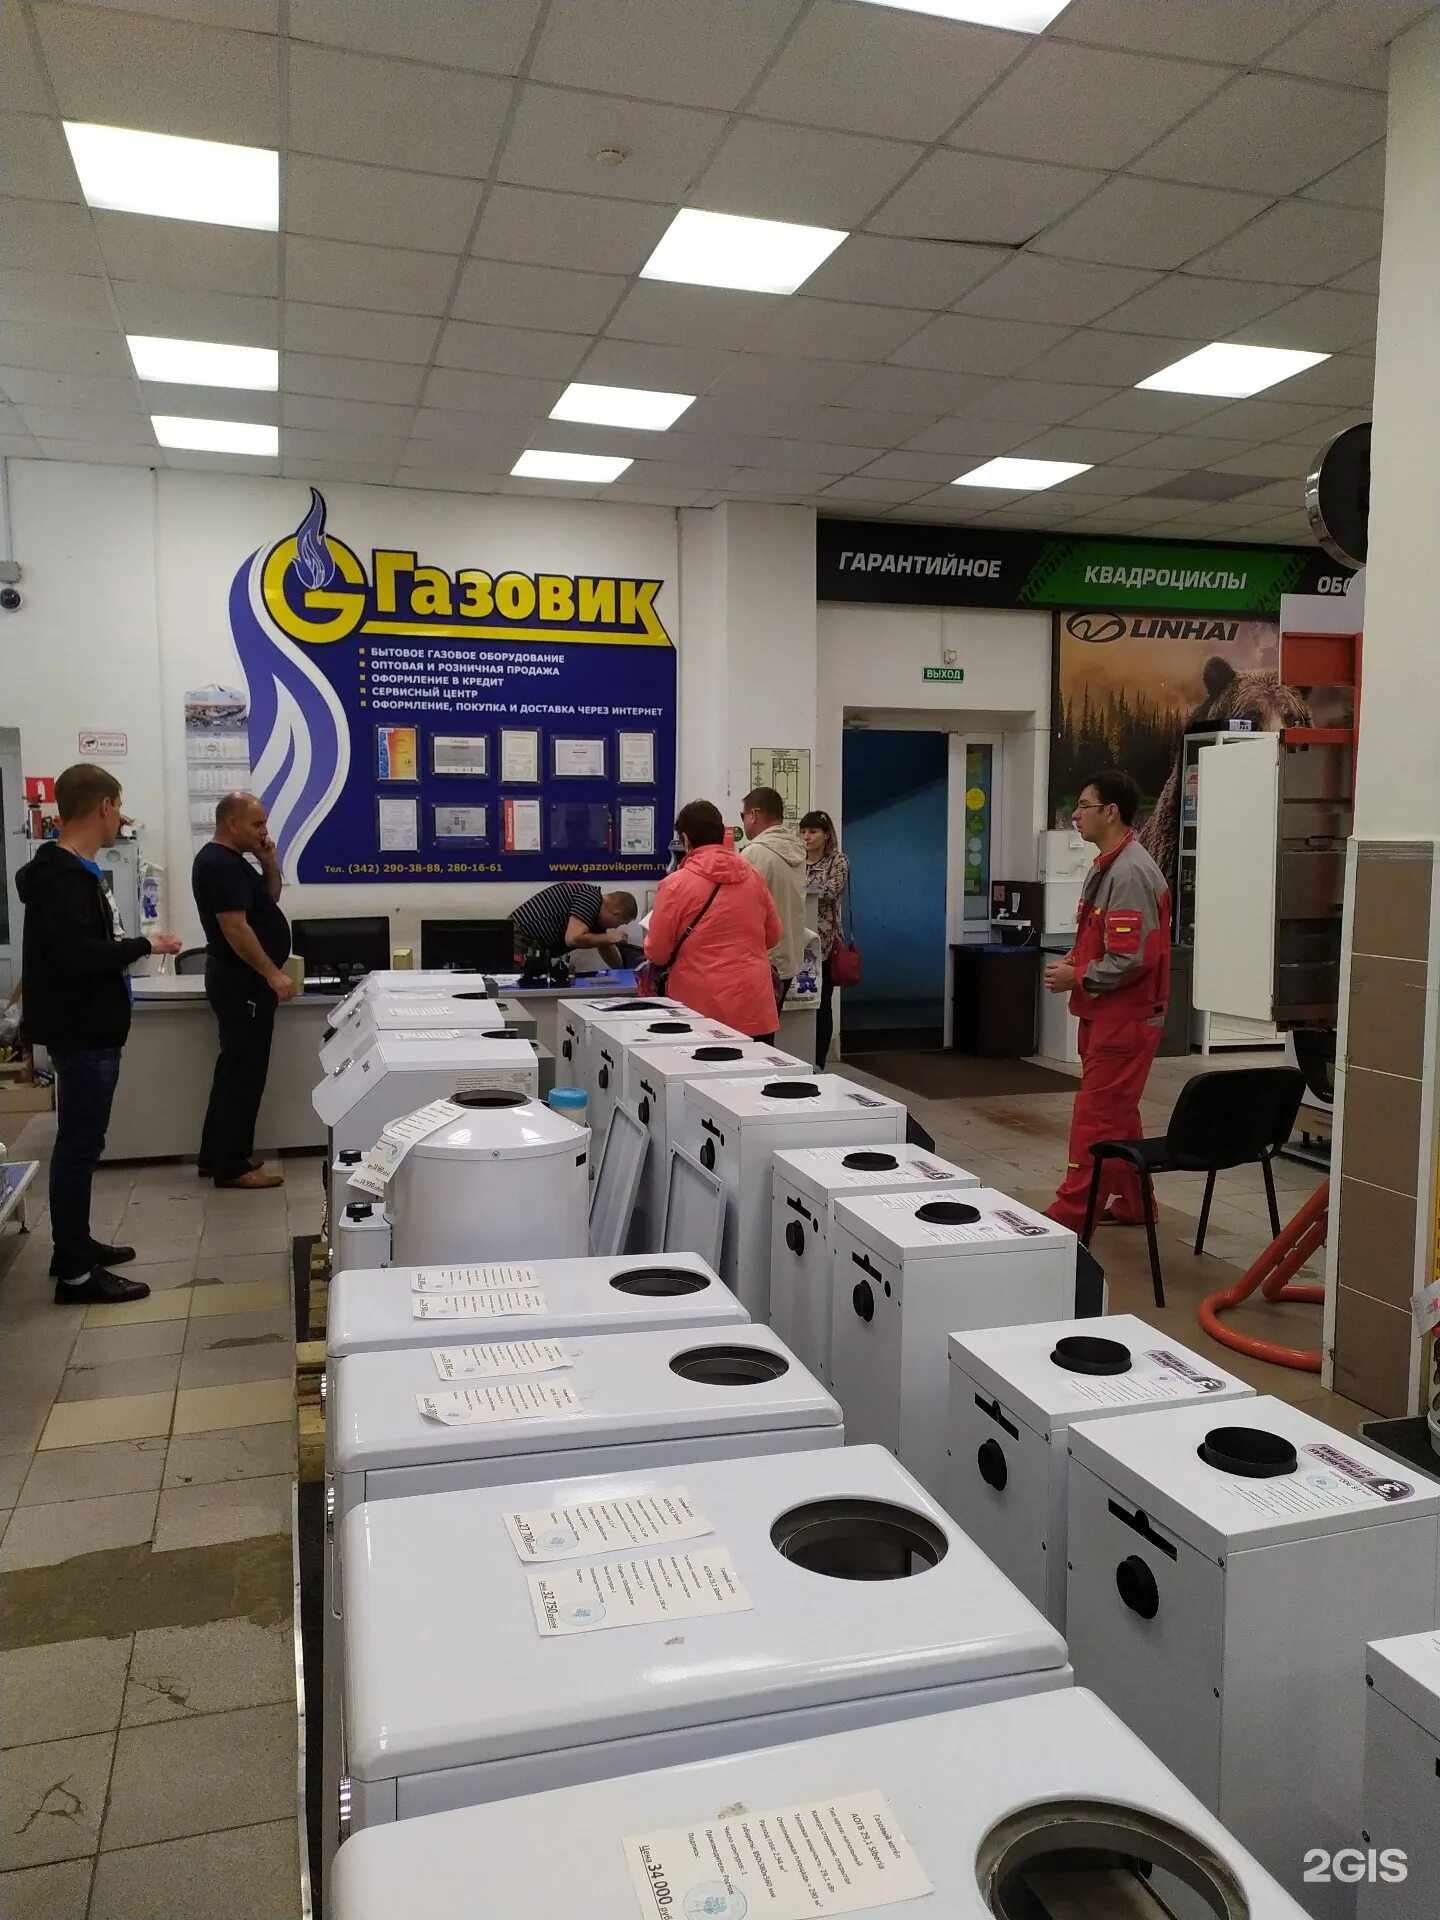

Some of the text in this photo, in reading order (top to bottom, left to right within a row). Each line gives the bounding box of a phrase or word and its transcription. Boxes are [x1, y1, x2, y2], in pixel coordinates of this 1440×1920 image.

[839, 552, 1002, 578] ГАРАНТИЙНОЕ
[1085, 566, 1247, 590] КВАДРОЦИКЛЫ
[373, 550, 662, 626] Газовик
[1130, 619, 1240, 641] LINHAI
[371, 648, 564, 663] БЫТОВОЕ ГАЗОВОЕ ОБОРУДОВАНИЕ
[371, 661, 559, 676] ОПТОВАЯ И РОЗНИЧНАЯ ПРОДАЖА
[926, 669, 961, 680] ВЫХОД
[372, 674, 504, 687] ОФОРМЛЕНИЕ В КРЕДИТ
[372, 685, 478, 700] СЕРВИСНЫЙ ЦЕНТР
[373, 700, 663, 716] ОФОРМЛЕНИЕ, ПОКУПКА И ДОСТАВКА ЧЕРЕЗ ИНТЕРНЕТ
[324, 863, 502, 874] Тел. (342) 290-38-88, 280-16-61
[549, 862, 668, 873] www.gazovikperm.ru
[518, 1523, 530, 1531] 27
[542, 1590, 555, 1599] 32
[545, 1600, 558, 1613] 750
[722, 1825, 735, 1843] Число
[757, 1819, 772, 1839] Расход
[826, 1806, 838, 1817] Тип
[840, 1835, 862, 1866] напольный
[872, 1813, 902, 1858] Газовый котёл
[808, 1809, 826, 1830] Камера
[831, 1857, 852, 1884] открытая
[849, 1812, 887, 1869] АОГВ 29,1 Siberia
[639, 1844, 655, 1863] Цена
[774, 1816, 798, 1854] Отапливаемая
[792, 1855, 810, 1882] площадь
[807, 1887, 819, 1899] 290
[791, 1812, 810, 1838] Тепловая
[824, 1882, 836, 1892] кВт
[646, 1863, 666, 1879] 34
[650, 1880, 675, 1905] 000
[721, 1874, 735, 1895] Ростов
[766, 1887, 777, 1898] мм
